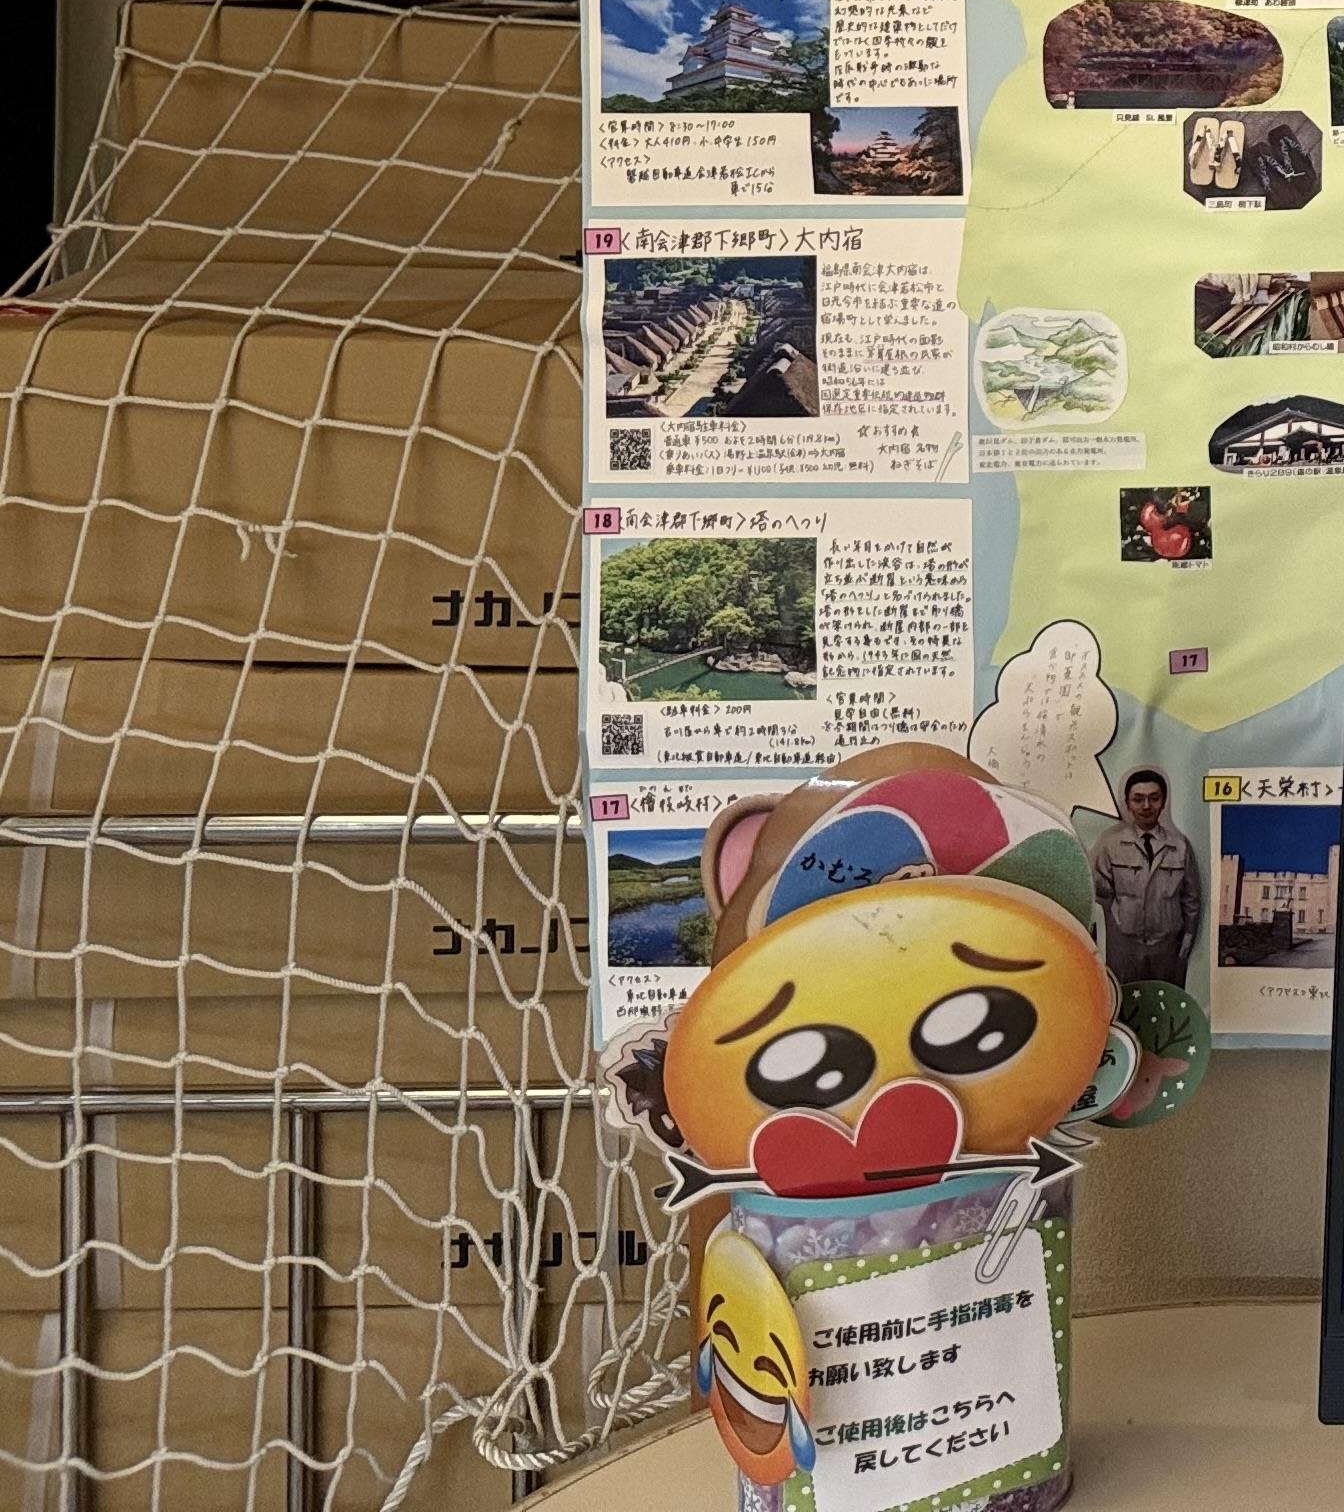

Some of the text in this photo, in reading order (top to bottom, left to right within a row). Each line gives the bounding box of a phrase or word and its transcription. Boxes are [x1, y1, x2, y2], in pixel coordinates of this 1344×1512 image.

[595, 233, 614, 249] 19
[594, 513, 612, 529] 18
[1182, 653, 1198, 667] 17
[1214, 781, 1233, 796] 16
[602, 799, 620, 815] 17
[809, 1284, 1035, 1355] ご使用前に手指消毒を
[807, 1343, 964, 1388] お願い致します
[813, 1388, 1018, 1450] ご使用後はこちらへ
[852, 1417, 1013, 1477] 戻してください
